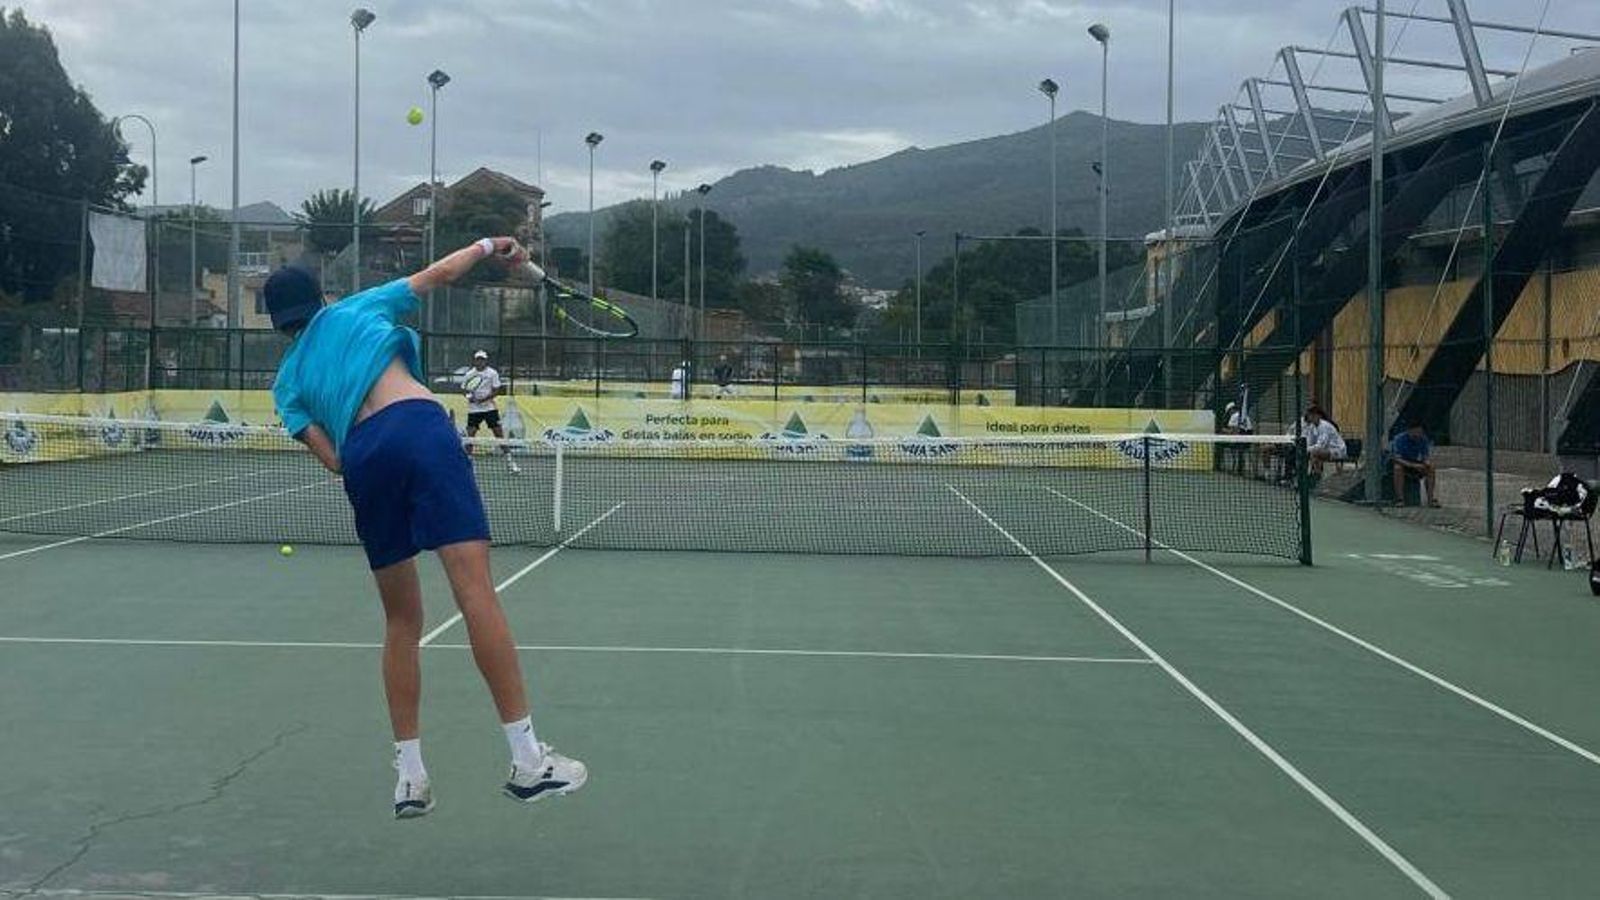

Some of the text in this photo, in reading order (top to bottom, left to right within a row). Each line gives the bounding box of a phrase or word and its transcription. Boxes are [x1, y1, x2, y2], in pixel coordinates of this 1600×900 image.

[645, 413, 729, 427] Perfecta para
[986, 421, 1091, 434] Ideal para dietas
[622, 429, 660, 440] dietas
[698, 432, 718, 440] en
